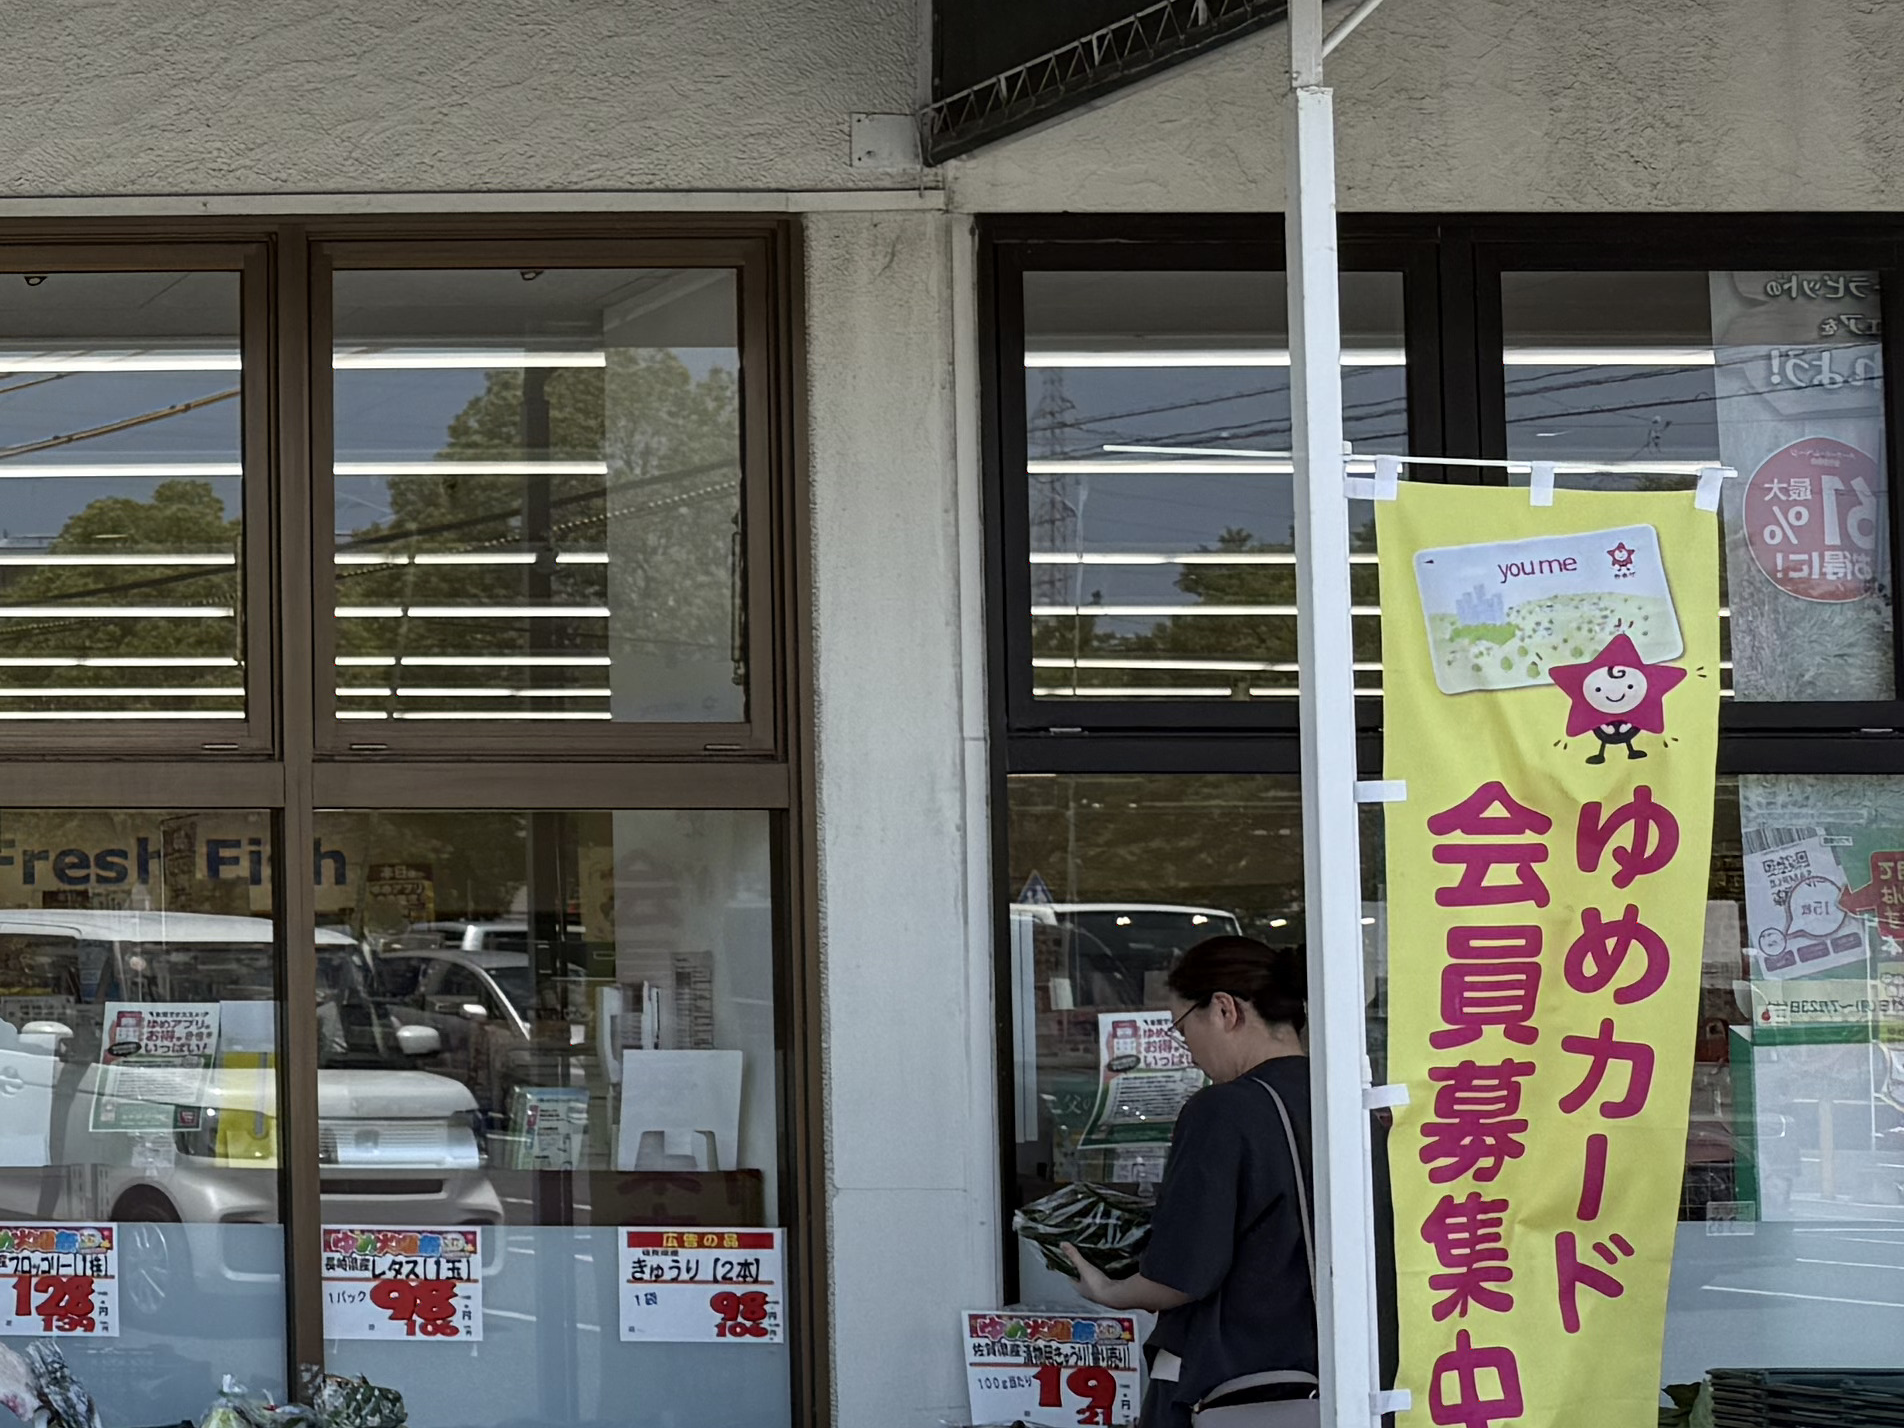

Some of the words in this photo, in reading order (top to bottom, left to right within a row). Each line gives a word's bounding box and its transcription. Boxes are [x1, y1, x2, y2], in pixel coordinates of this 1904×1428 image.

[204, 837, 346, 887] Fih
[1557, 784, 1681, 1335] ゆめカード
[662, 1233, 739, 1248] 広告の品
[12, 1275, 96, 1317] 128
[328, 1290, 367, 1304] 1パック
[370, 1279, 459, 1321] 98
[709, 1291, 769, 1322] 98
[405, 1319, 460, 1337] 106
[714, 1321, 769, 1338] 106
[1032, 1366, 1117, 1408] 19
